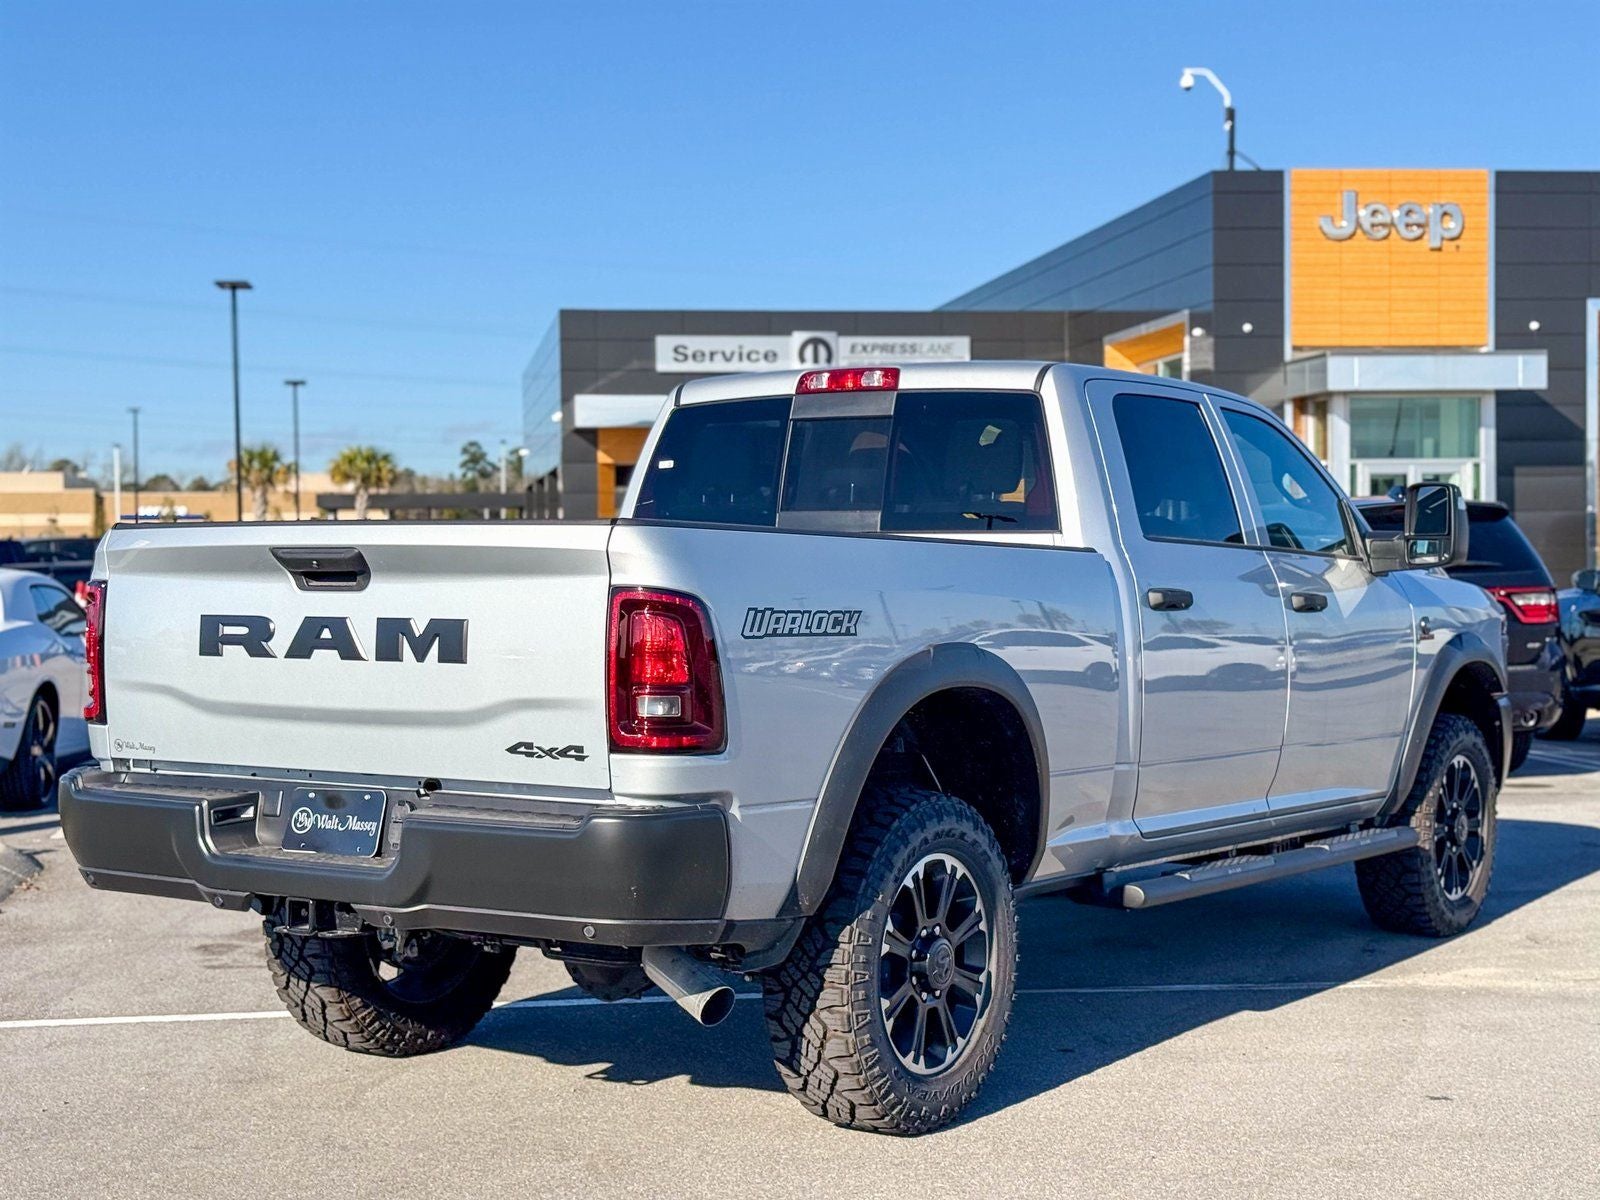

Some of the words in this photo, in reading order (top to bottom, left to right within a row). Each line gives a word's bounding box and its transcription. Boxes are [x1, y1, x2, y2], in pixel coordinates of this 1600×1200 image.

[1319, 190, 1464, 251] Jeep
[672, 344, 778, 363] Service
[199, 614, 469, 664] RAM
[313, 813, 340, 830] Walt
[338, 815, 378, 837] Massey
